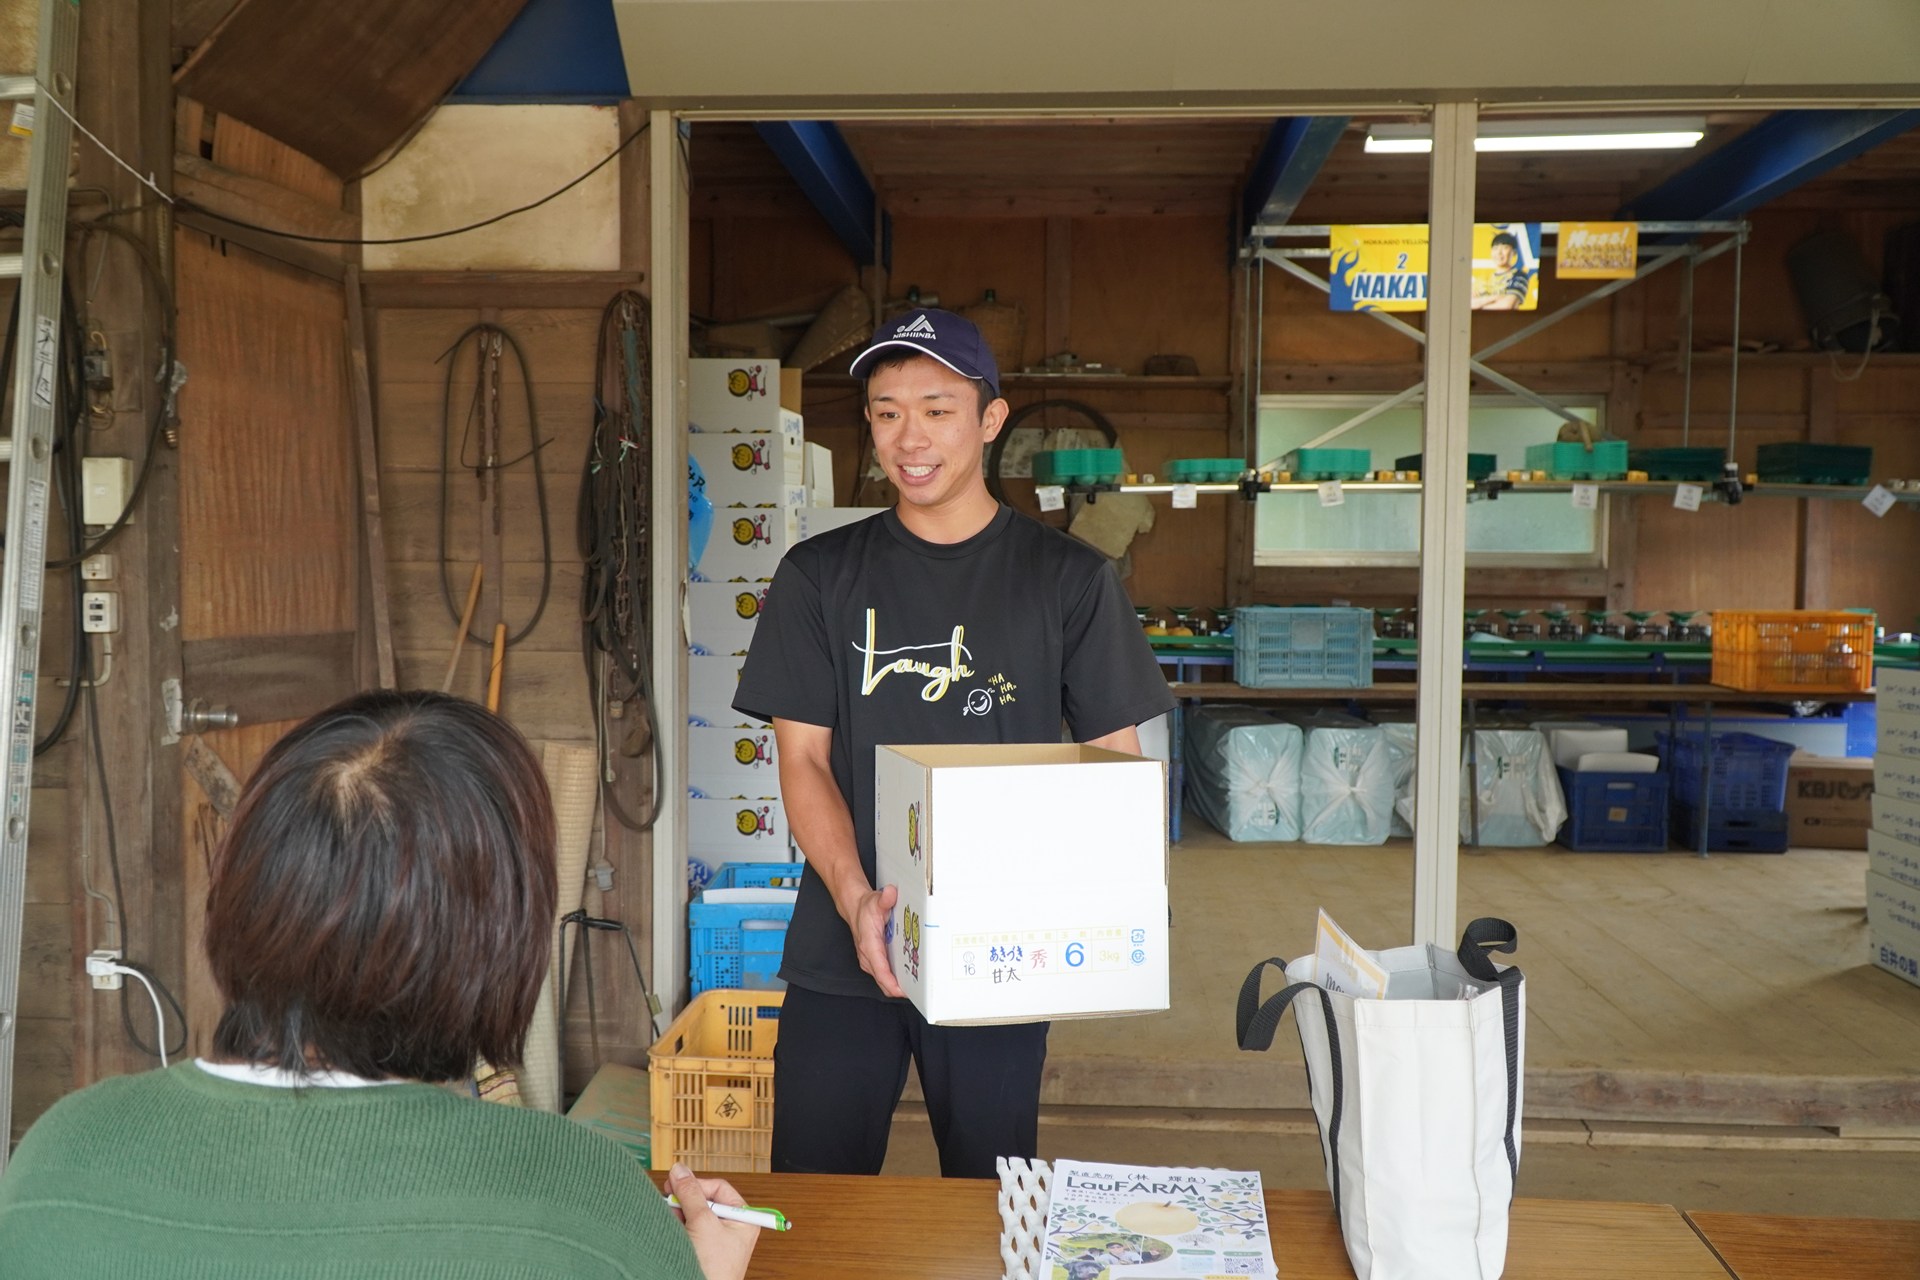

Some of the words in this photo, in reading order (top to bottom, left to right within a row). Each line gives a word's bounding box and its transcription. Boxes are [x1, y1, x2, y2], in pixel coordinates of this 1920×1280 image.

[1397, 253, 1408, 270] 2
[892, 331, 937, 341] NISHIINBA
[851, 608, 976, 702] Laugh
[989, 945, 1023, 963] あきづき
[1029, 948, 1048, 970] 秀
[1065, 941, 1085, 968] 6
[963, 963, 976, 977] 16
[1066, 1176, 1200, 1196] LauFARM
